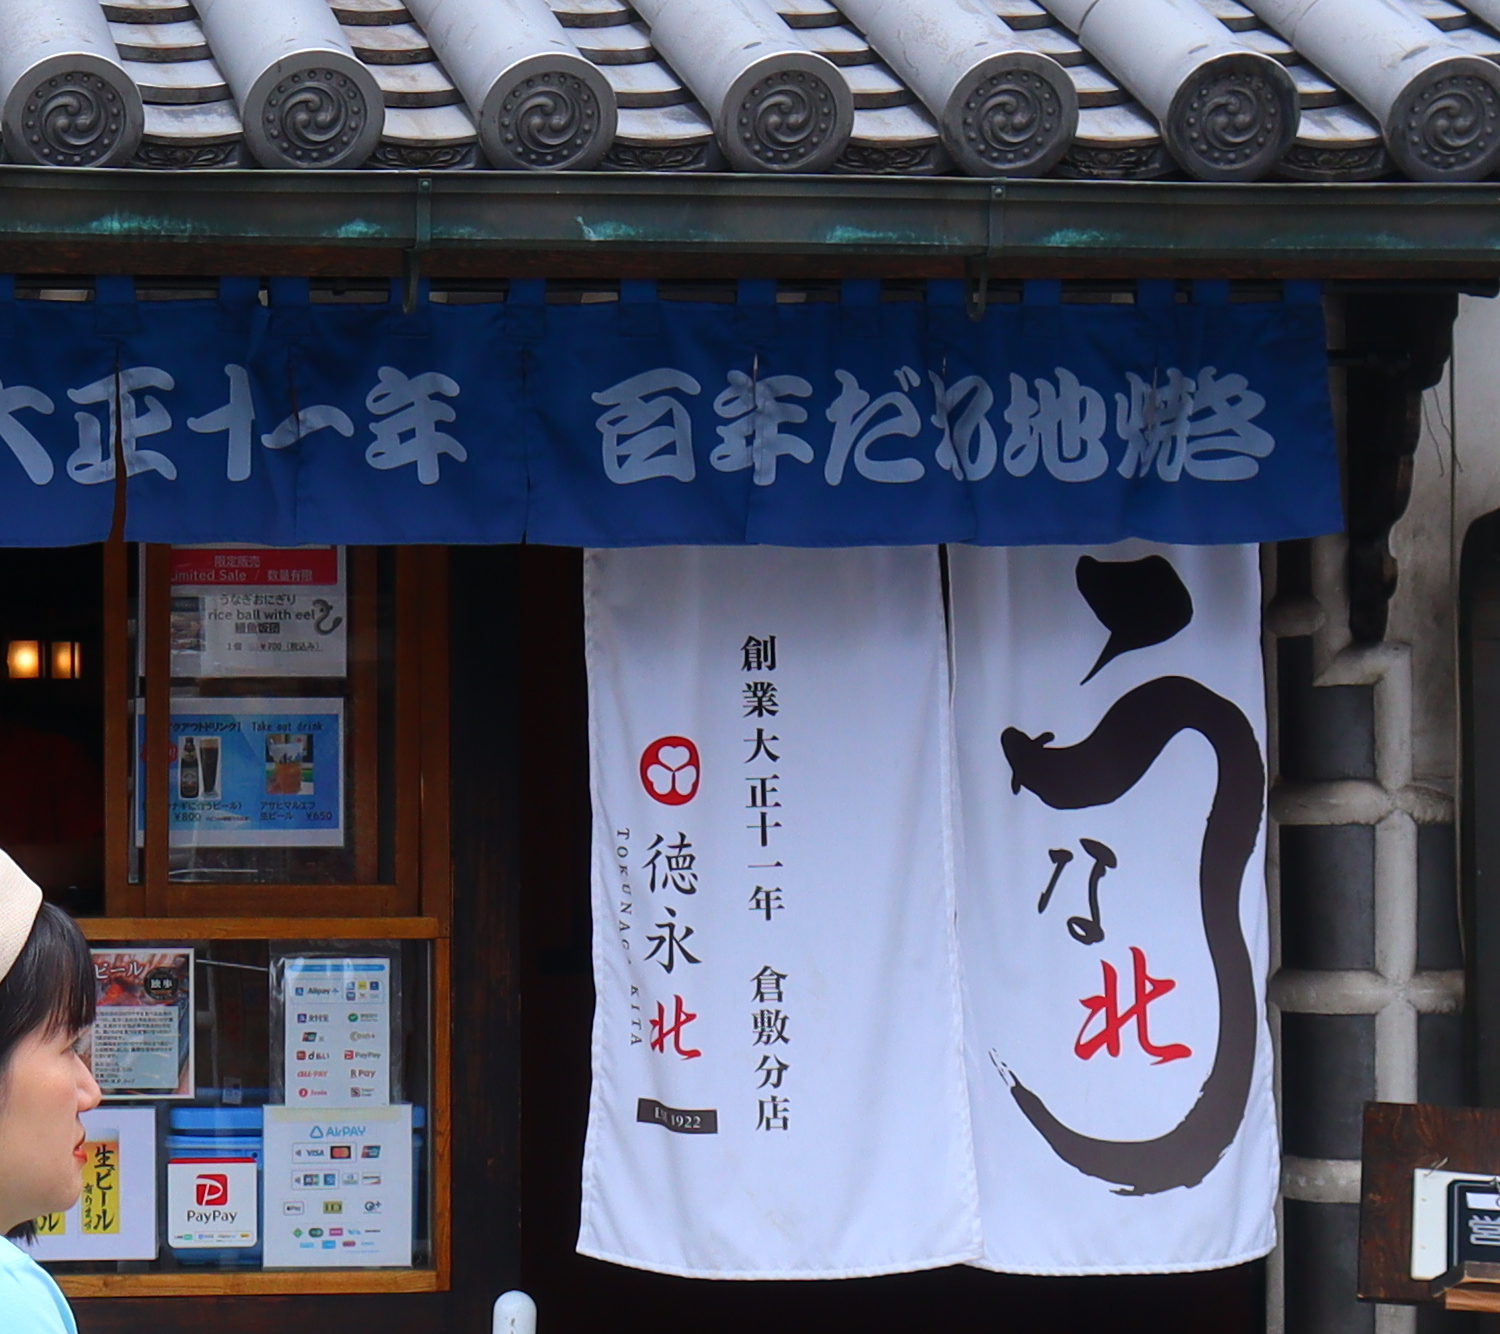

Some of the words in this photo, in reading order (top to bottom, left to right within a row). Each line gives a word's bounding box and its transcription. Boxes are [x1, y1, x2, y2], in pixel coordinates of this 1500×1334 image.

[219, 569, 247, 581] Sale
[219, 593, 297, 606] うなぎおにぎり
[208, 610, 232, 621] rice
[237, 609, 261, 621] ball
[264, 609, 292, 621] with
[295, 609, 316, 621] eel
[252, 721, 272, 732] Take
[277, 722, 292, 732] out
[298, 721, 323, 732] drink
[740, 634, 785, 922] 創業大正十一年
[750, 965, 792, 1133] 倉敷分店
[671, 1113, 702, 1129] 1922
[93, 1144, 116, 1231] 生ビール
[186, 1209, 238, 1224] PayPay
